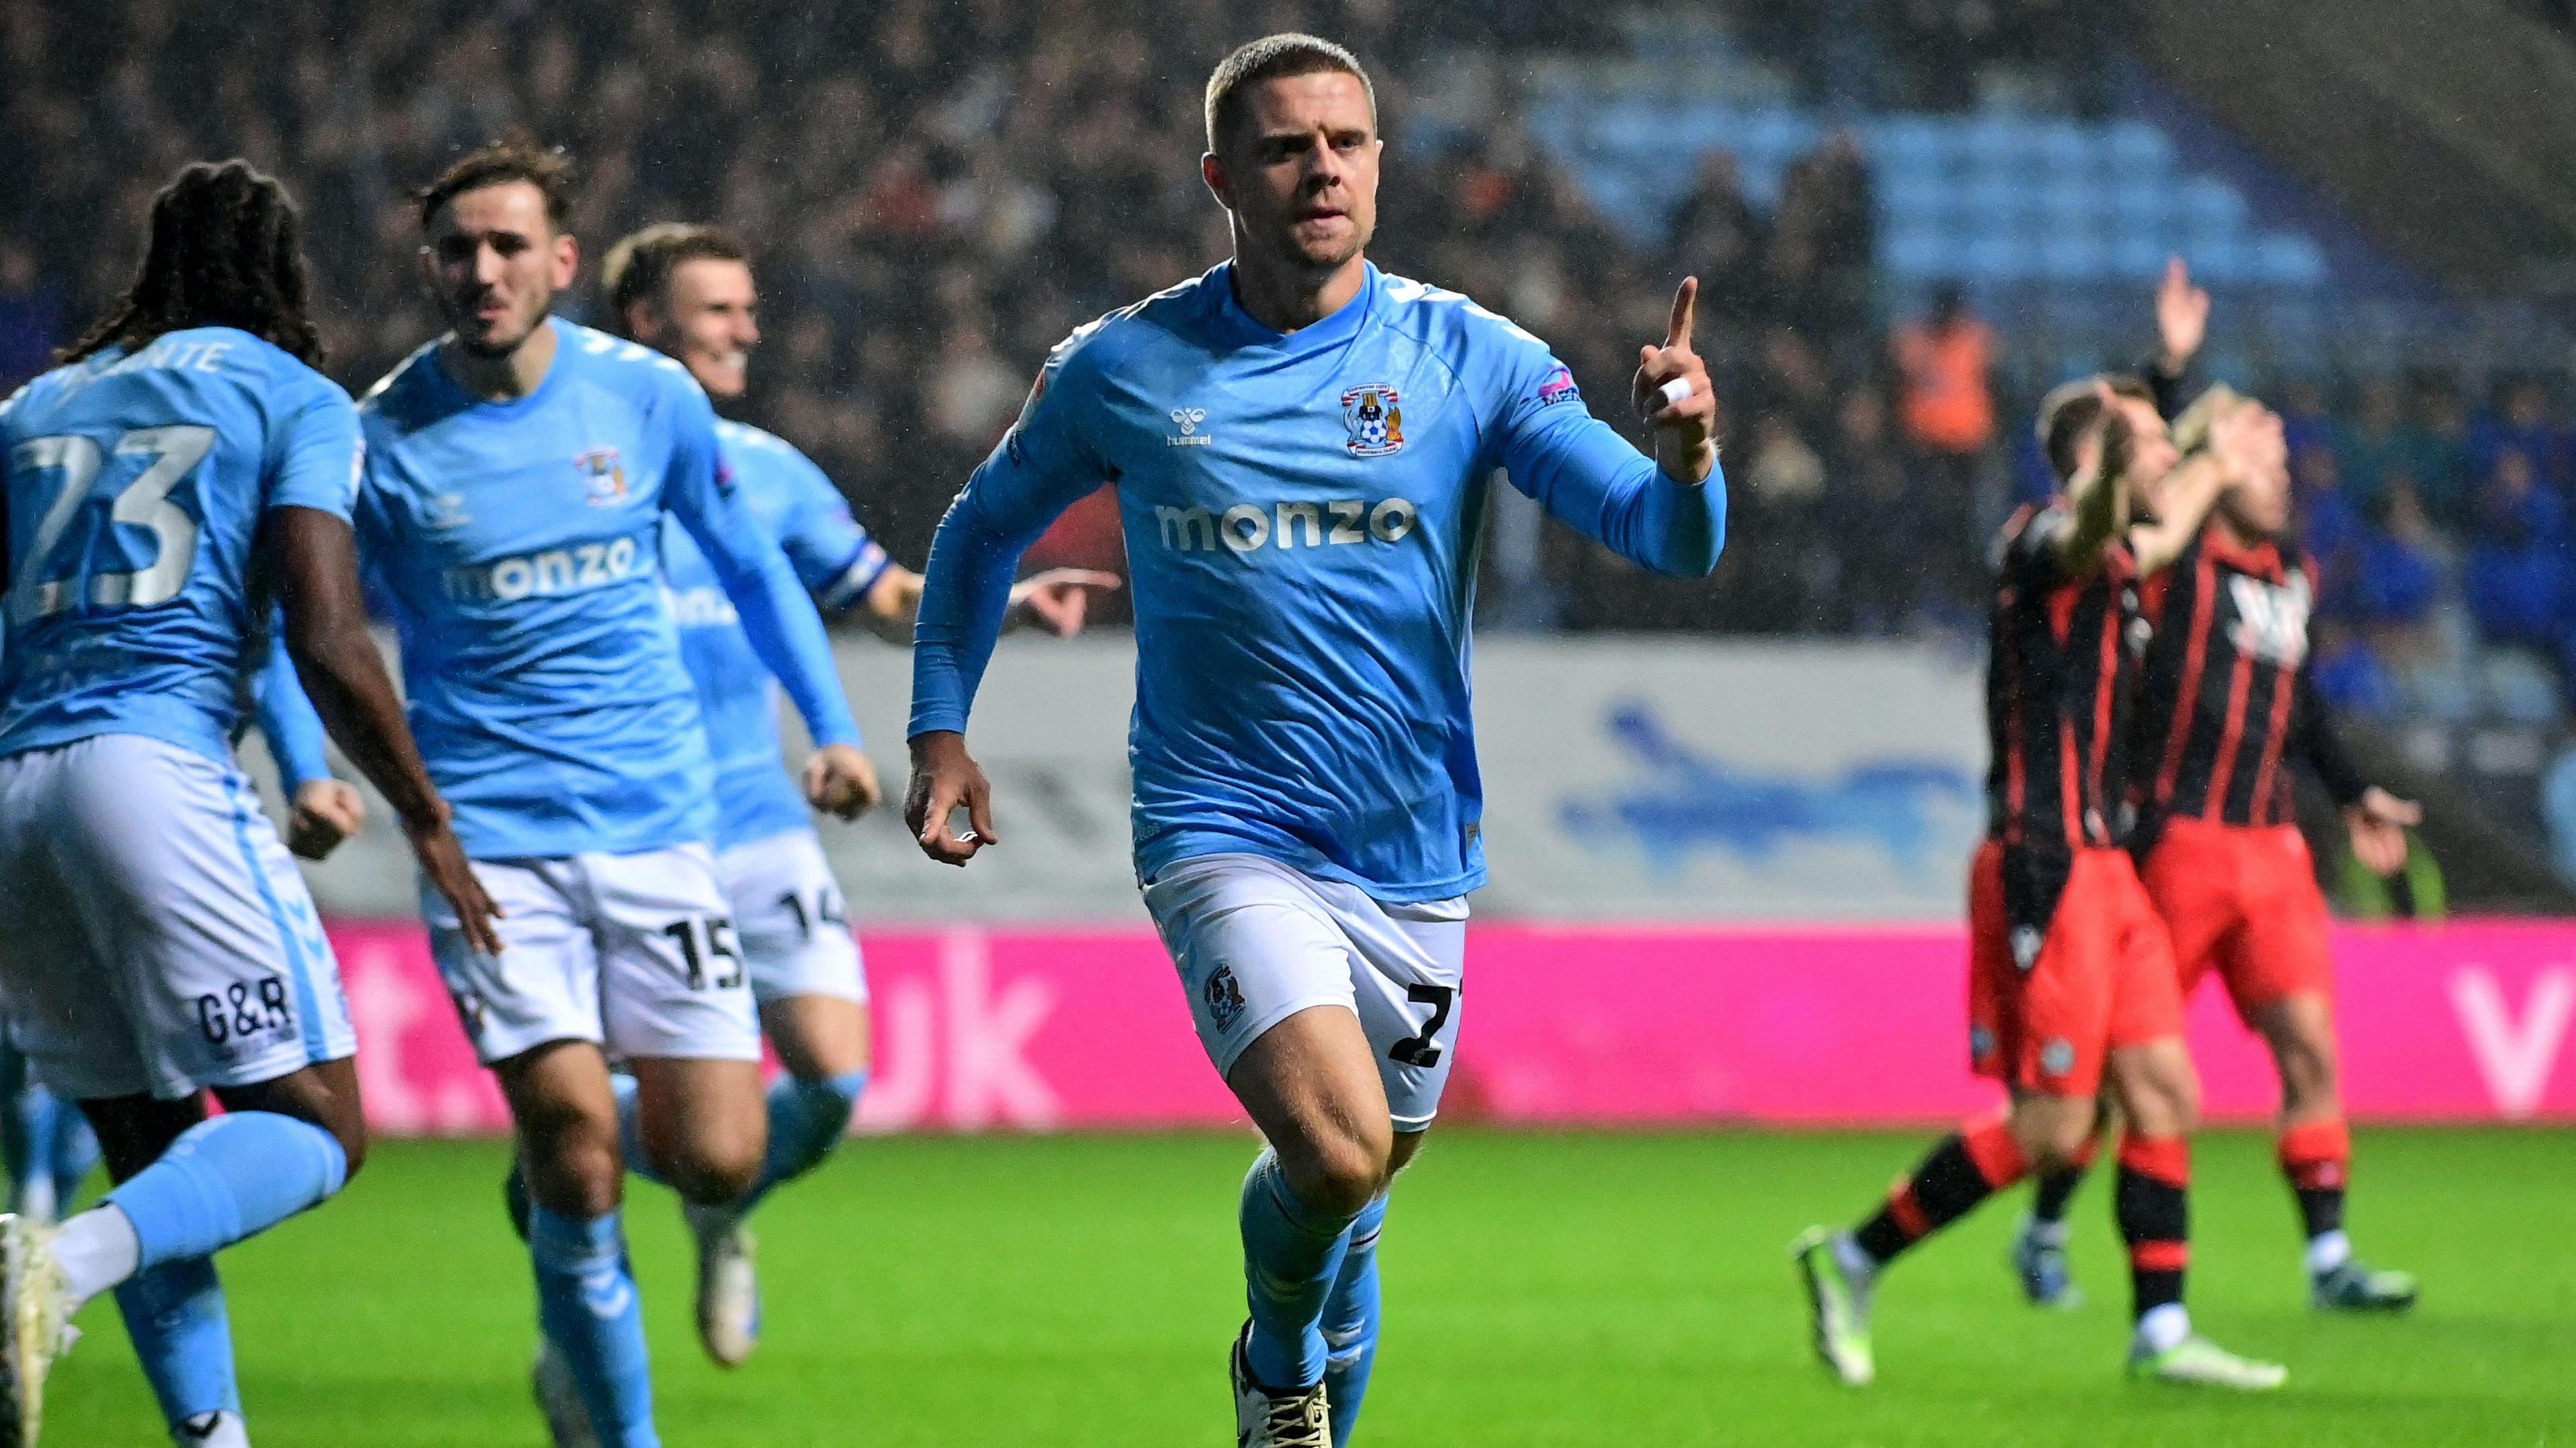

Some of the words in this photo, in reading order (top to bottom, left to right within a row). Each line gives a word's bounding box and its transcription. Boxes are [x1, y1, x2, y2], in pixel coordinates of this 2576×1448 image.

[1167, 434, 1211, 447] hummel
[4, 424, 216, 624] 23
[1155, 497, 1416, 552] monzo
[440, 537, 637, 600] monzo
[664, 918, 743, 991] 15
[198, 972, 294, 1044] G&R
[1389, 977, 1463, 1068] 2
